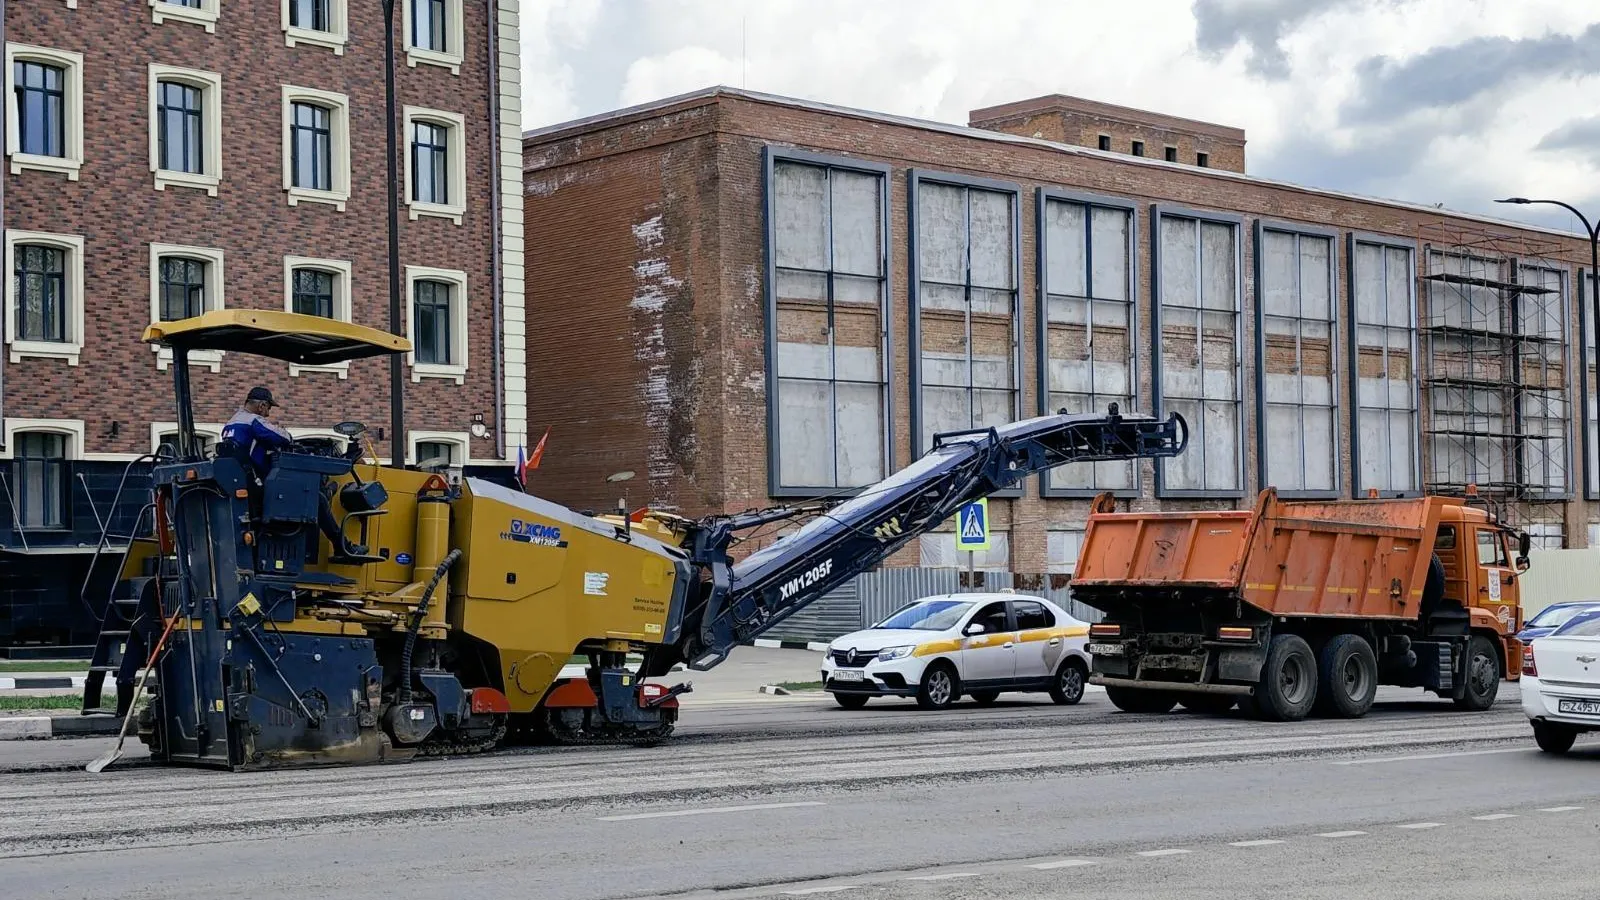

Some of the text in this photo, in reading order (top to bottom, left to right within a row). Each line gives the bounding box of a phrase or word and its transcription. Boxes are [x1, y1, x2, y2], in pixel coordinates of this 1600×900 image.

[524, 522, 561, 540] XCMG
[529, 536, 560, 547] XM1205F
[779, 558, 833, 601] XM1205F
